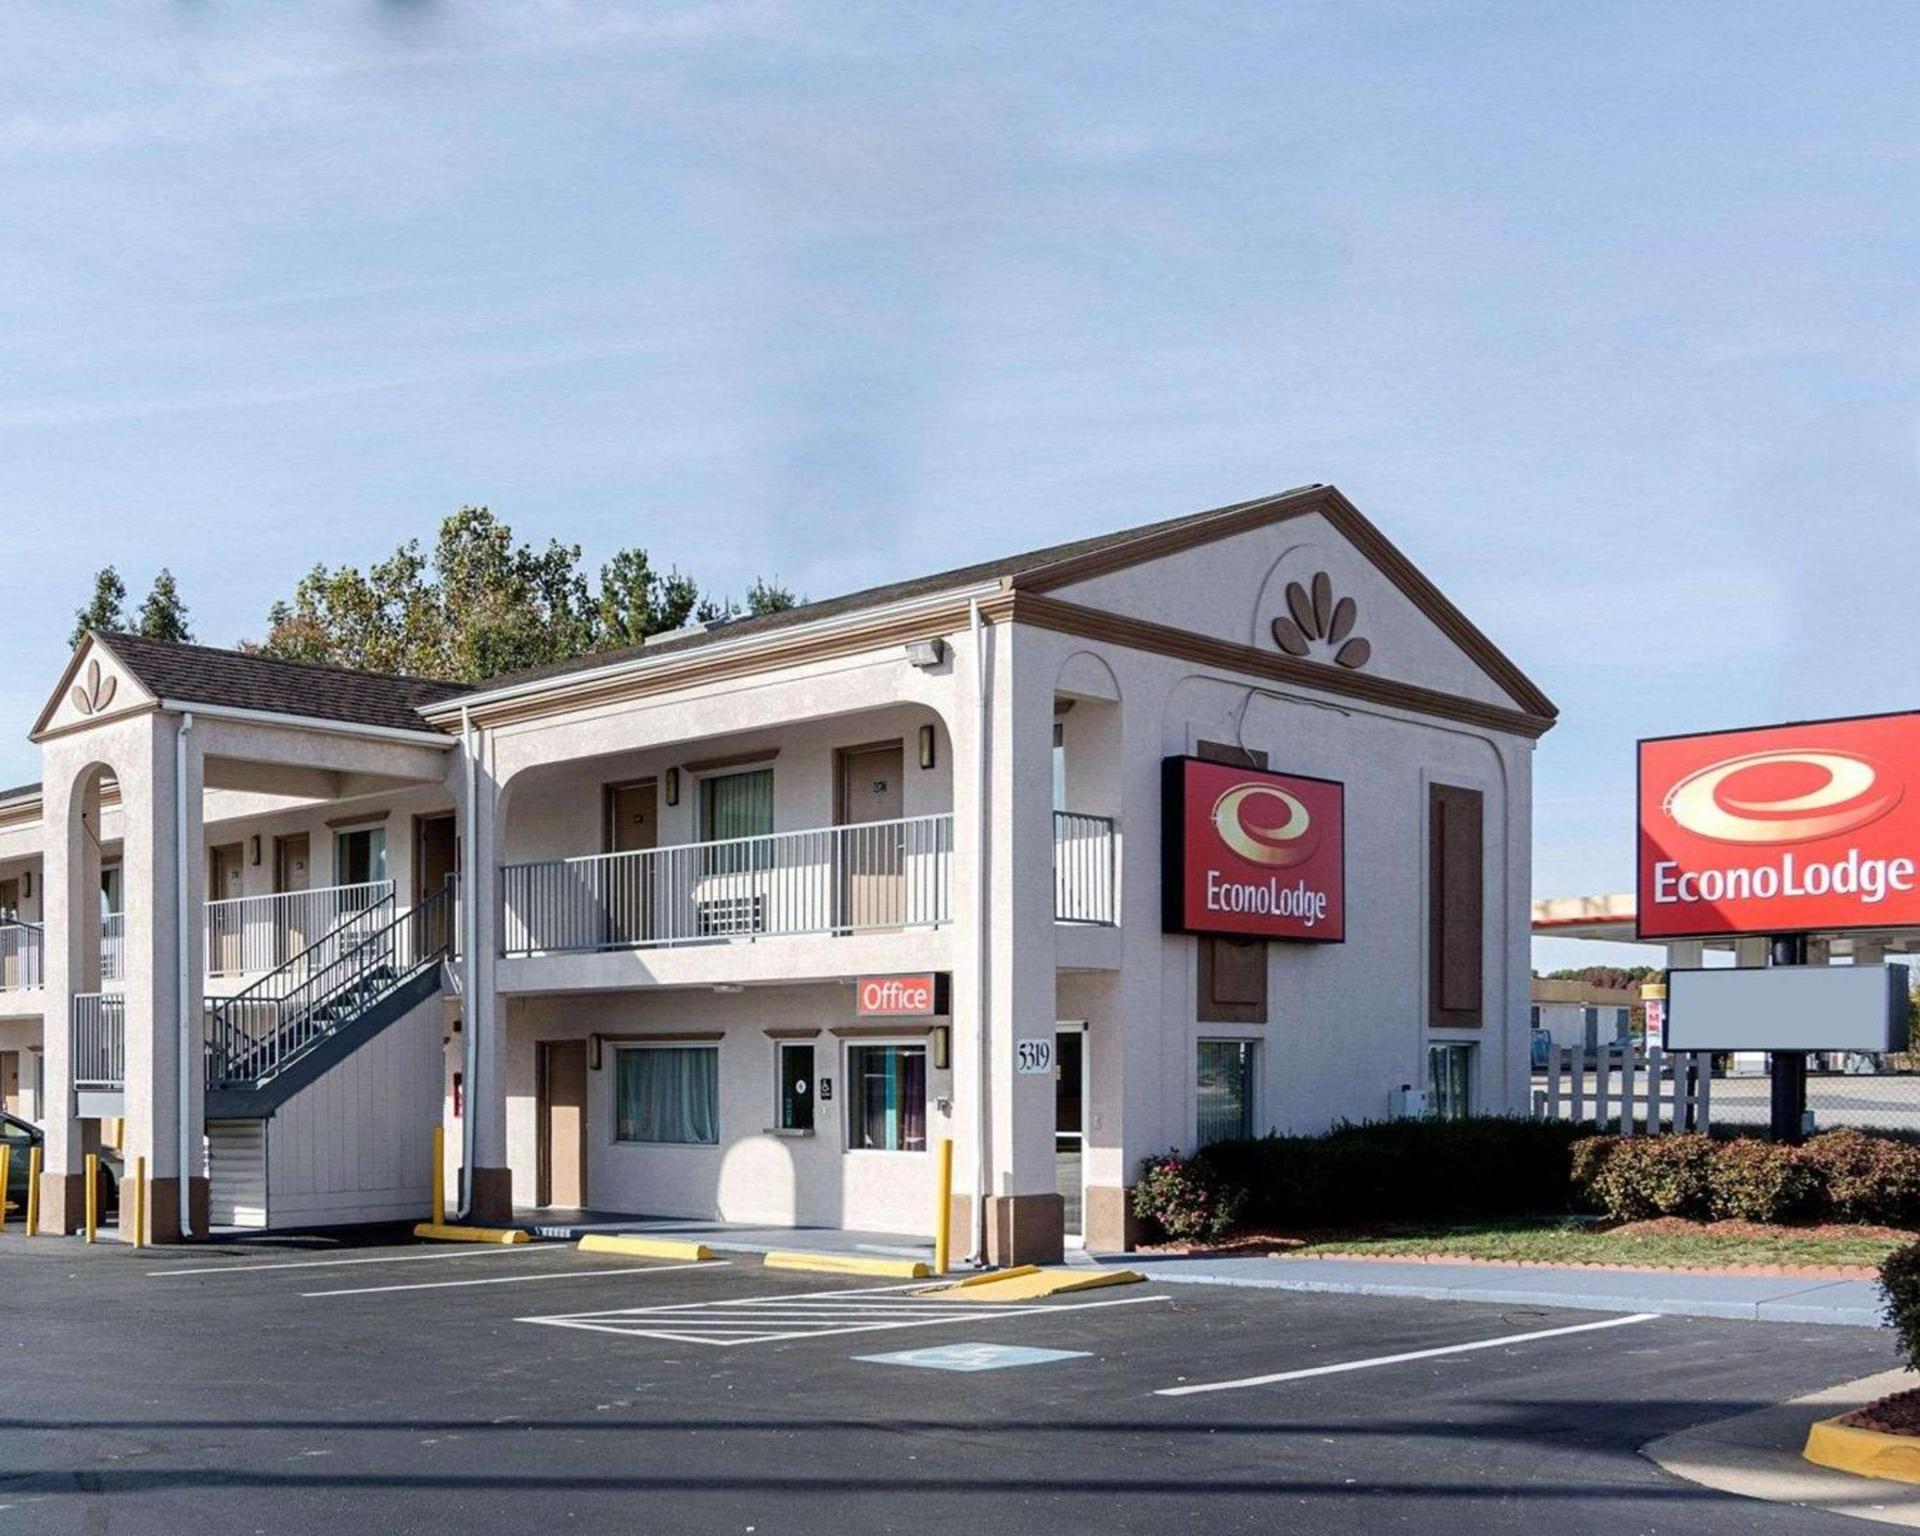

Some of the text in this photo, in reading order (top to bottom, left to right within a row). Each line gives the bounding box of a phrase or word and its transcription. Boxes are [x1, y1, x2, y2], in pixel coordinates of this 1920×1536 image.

[1655, 848, 1915, 904] EconoLodge
[1206, 870, 1327, 927] EconoLodge
[863, 983, 928, 1011] Office
[1019, 1042, 1050, 1071] 5319
